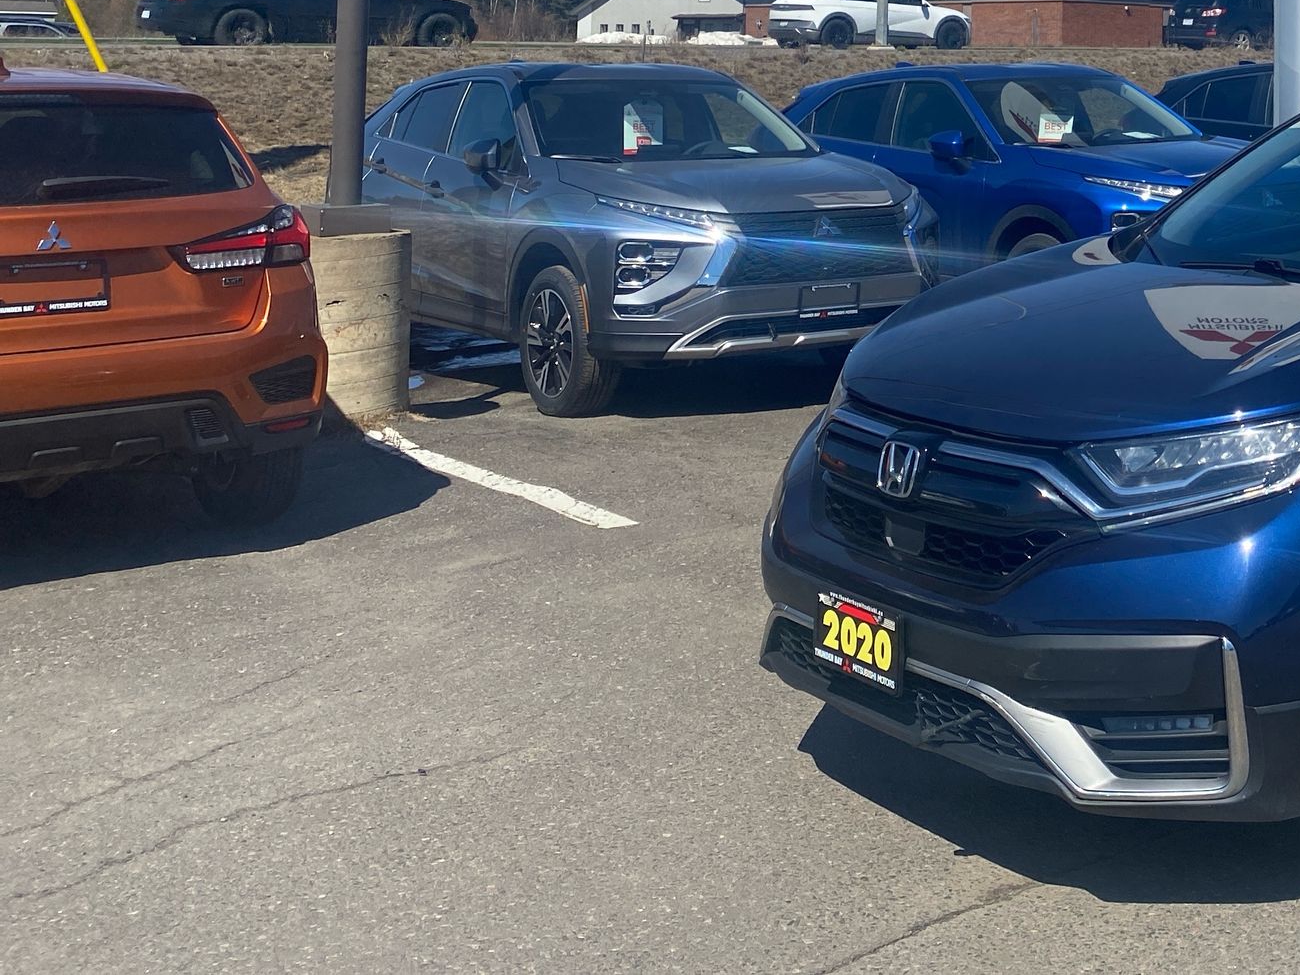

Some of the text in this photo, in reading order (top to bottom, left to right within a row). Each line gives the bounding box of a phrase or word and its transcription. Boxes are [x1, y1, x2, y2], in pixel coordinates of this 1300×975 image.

[1044, 122, 1068, 130] BEST
[49, 301, 83, 310] MITSUBISHI
[84, 299, 107, 308] MOTORS
[822, 609, 892, 672] 2020
[814, 647, 896, 690] THUNDER BAY MITSUBISHI MOTORS
